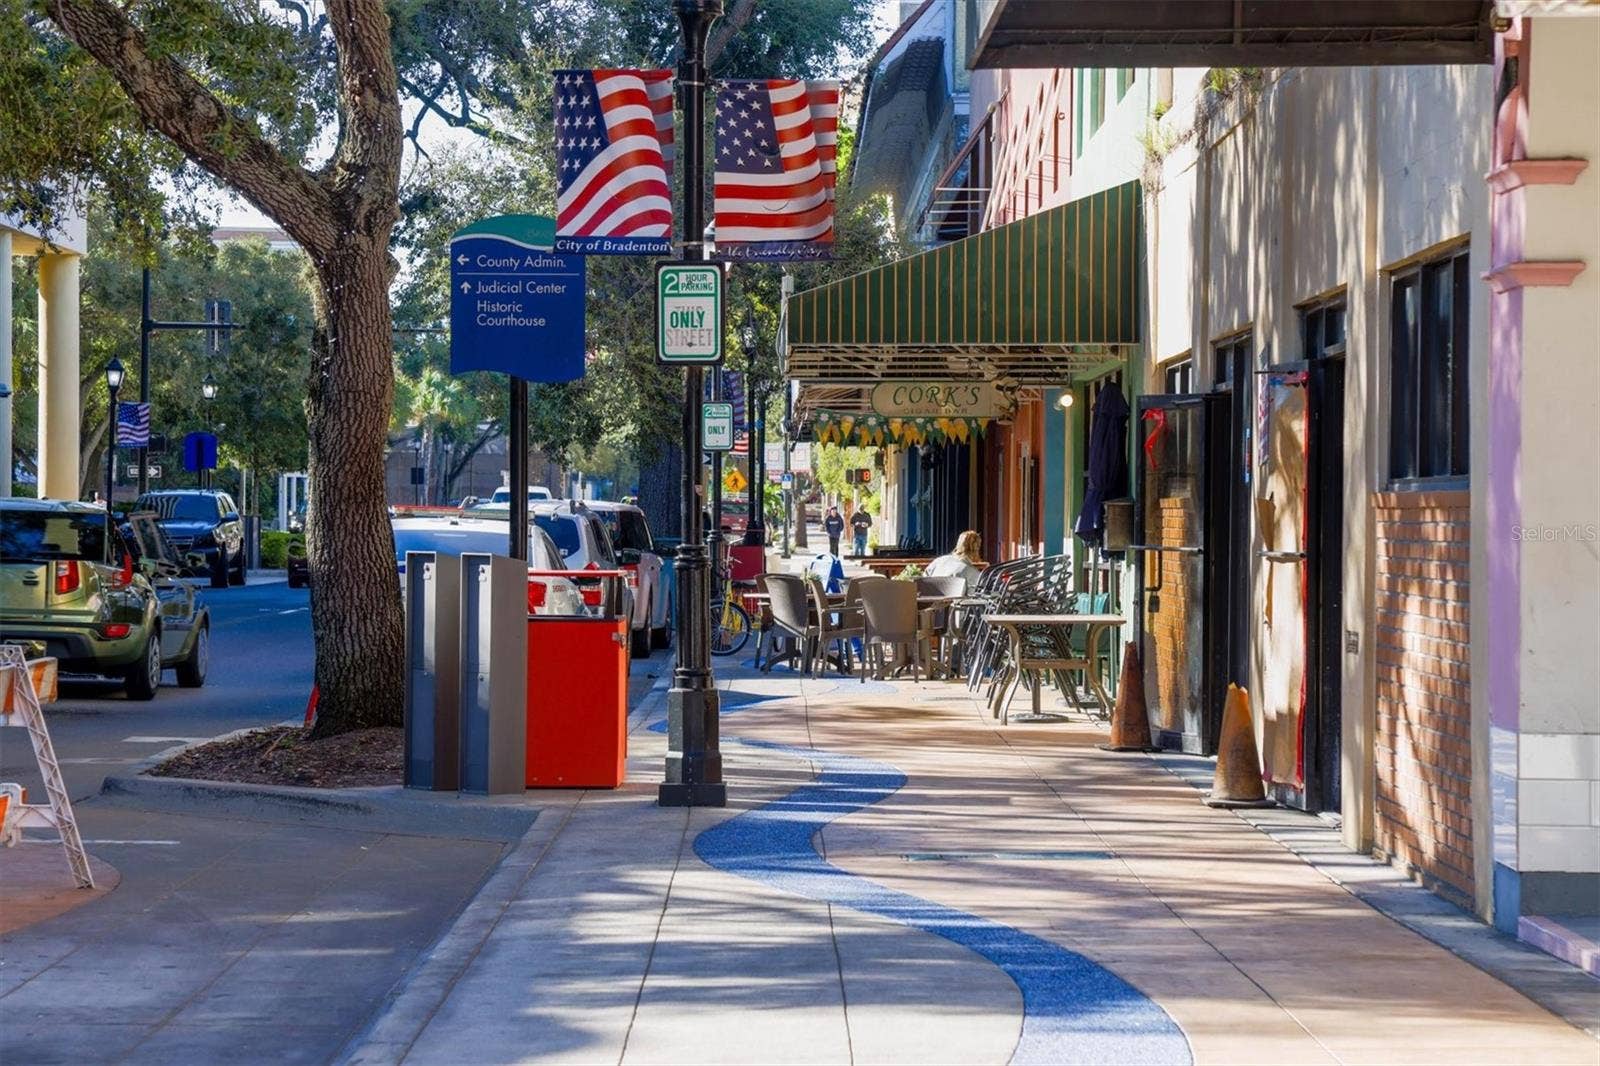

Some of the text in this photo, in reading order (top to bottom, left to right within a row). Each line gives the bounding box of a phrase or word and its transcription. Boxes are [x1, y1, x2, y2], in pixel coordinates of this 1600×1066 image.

[556, 240, 670, 253] City of Bradenton
[476, 255, 566, 271] County Admin.
[664, 273, 678, 294] 2
[685, 274, 708, 282] HOUR
[476, 280, 567, 294] Judicial Center
[681, 283, 713, 291] PARKING
[477, 300, 523, 313] Historic
[476, 314, 546, 326] Courthouse
[670, 310, 705, 328] ONLY
[666, 329, 713, 347] STREET
[893, 385, 980, 407] CORK'S
[705, 406, 713, 417] 2
[707, 425, 726, 435] ONLY
